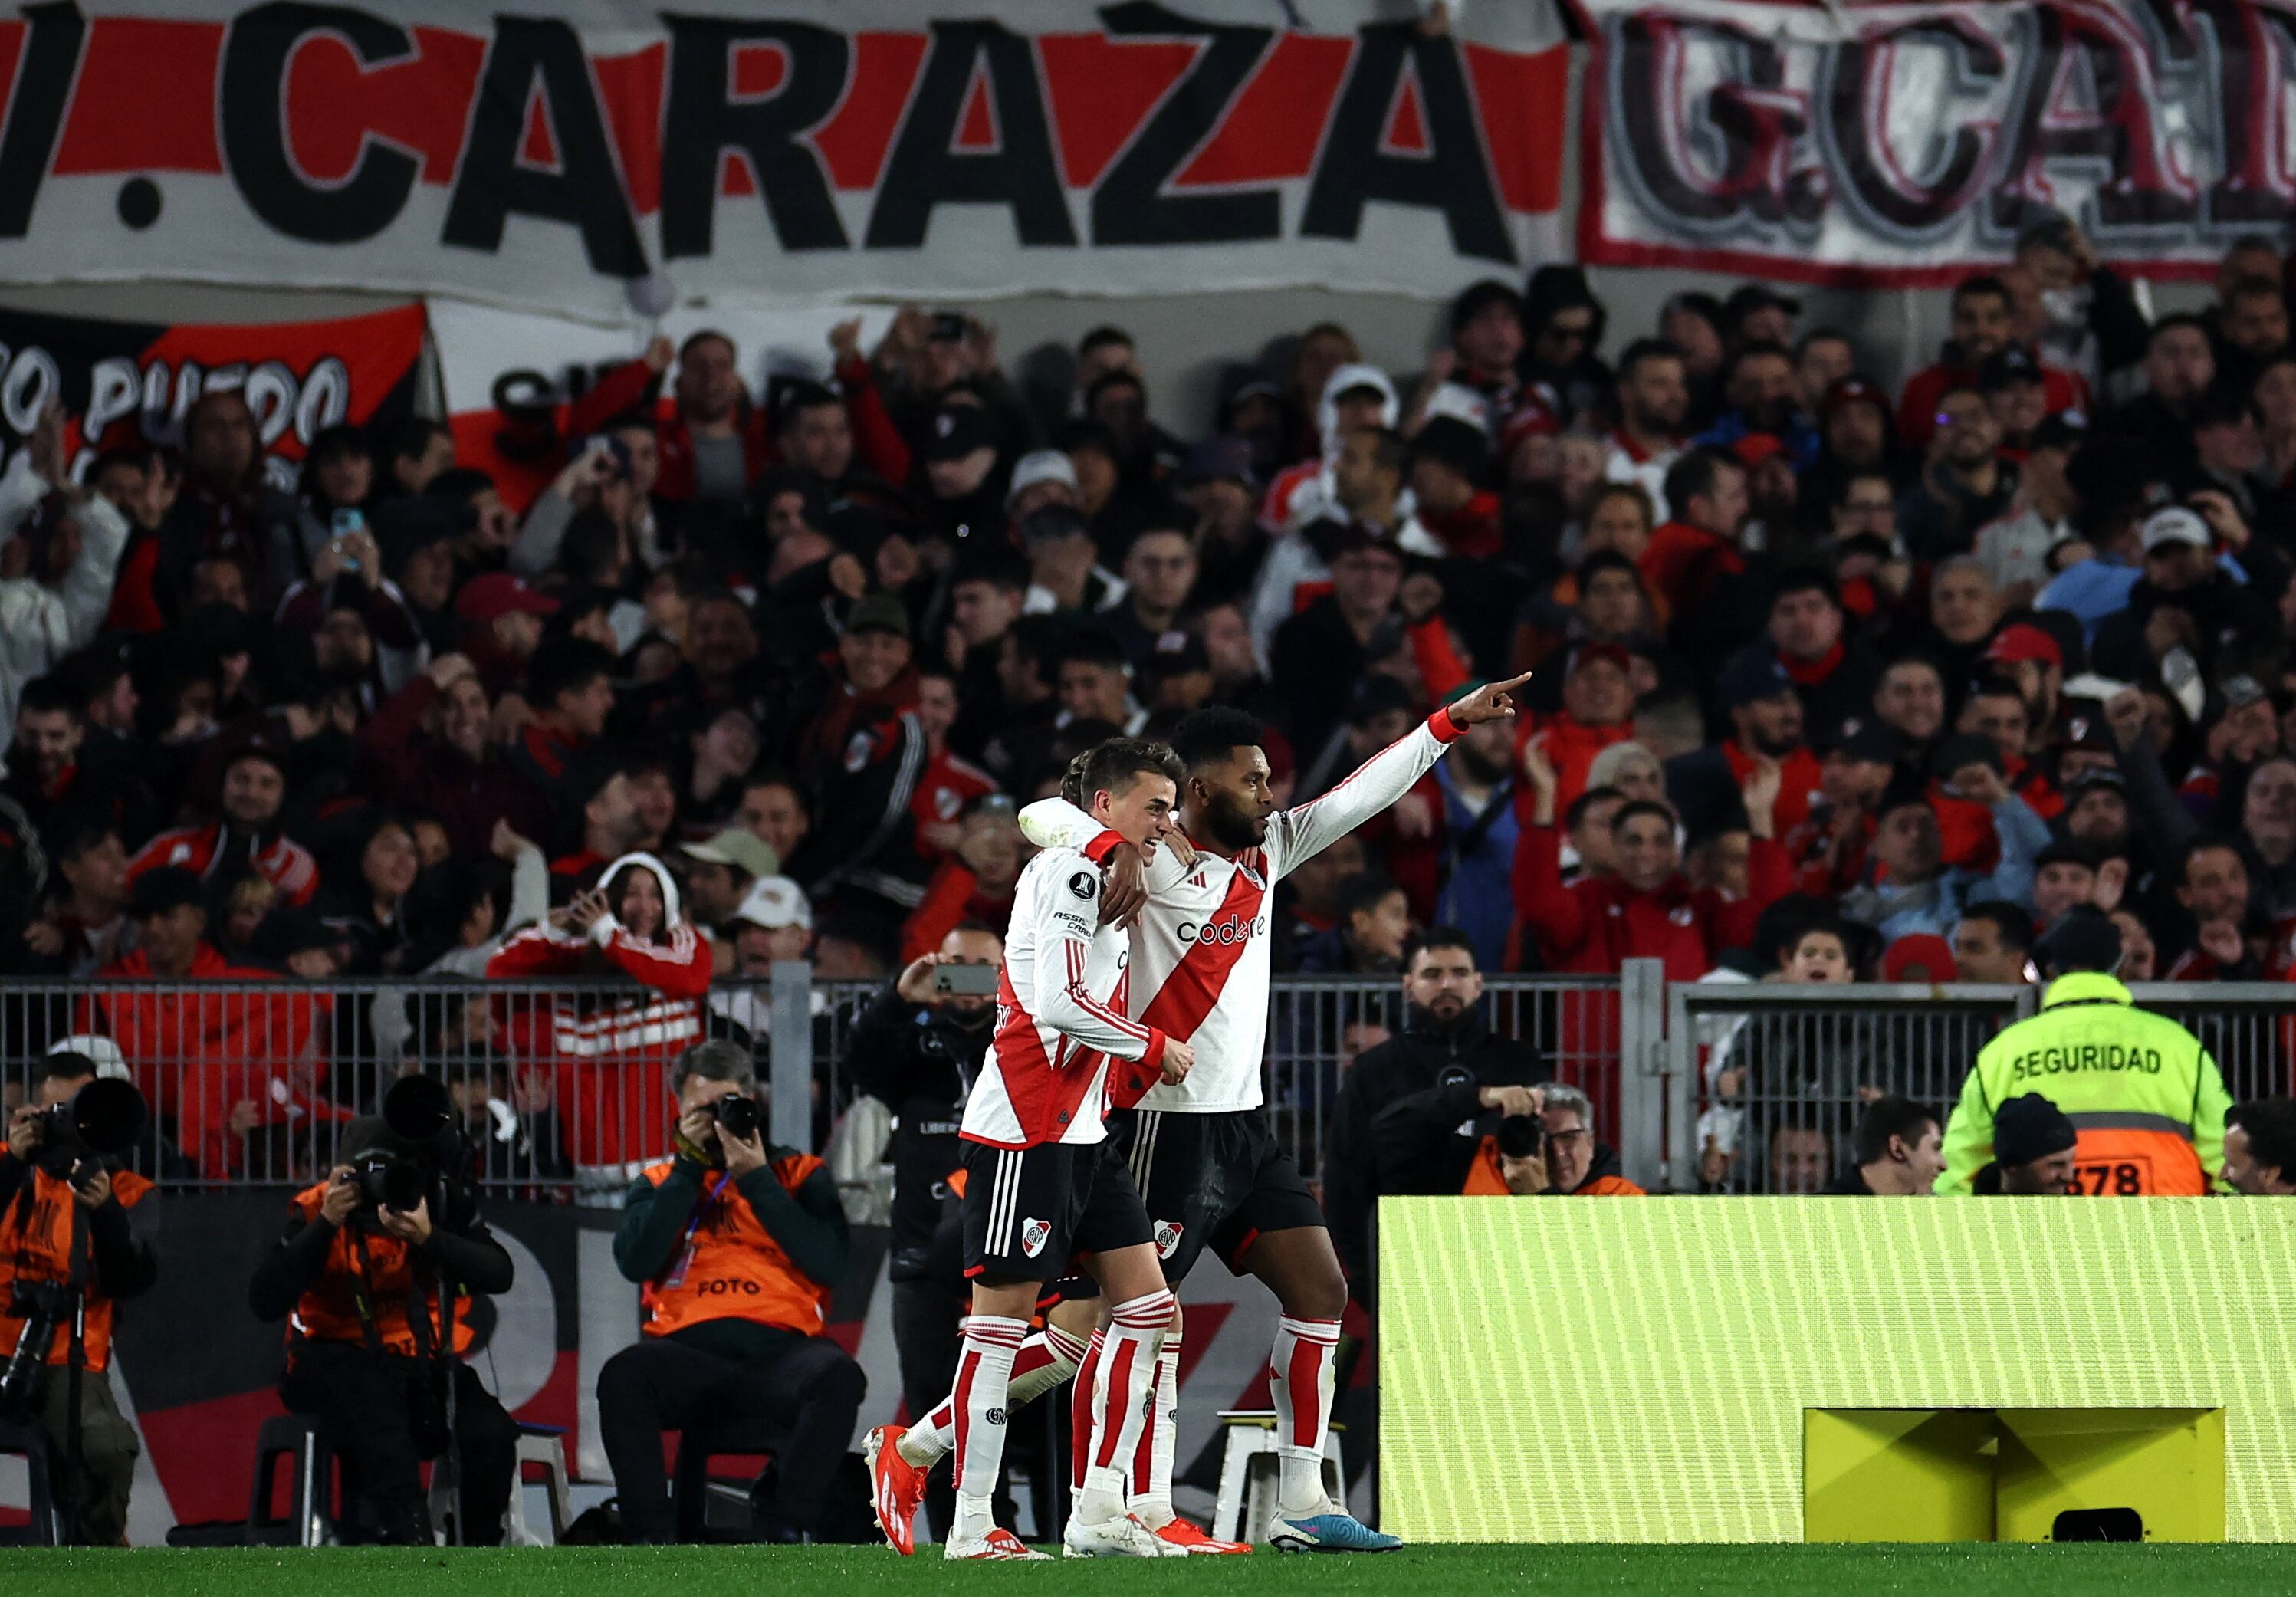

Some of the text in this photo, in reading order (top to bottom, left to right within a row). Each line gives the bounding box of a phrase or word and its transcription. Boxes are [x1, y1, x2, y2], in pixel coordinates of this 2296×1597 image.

[219, 0, 1521, 278] CARAZA
[0, 343, 350, 449] O PUDO
[1066, 921, 1092, 938] CARD
[1175, 913, 1266, 946] codere
[2013, 1044, 2162, 1081] SEGURIDAD
[697, 1278, 760, 1298] FOTO
